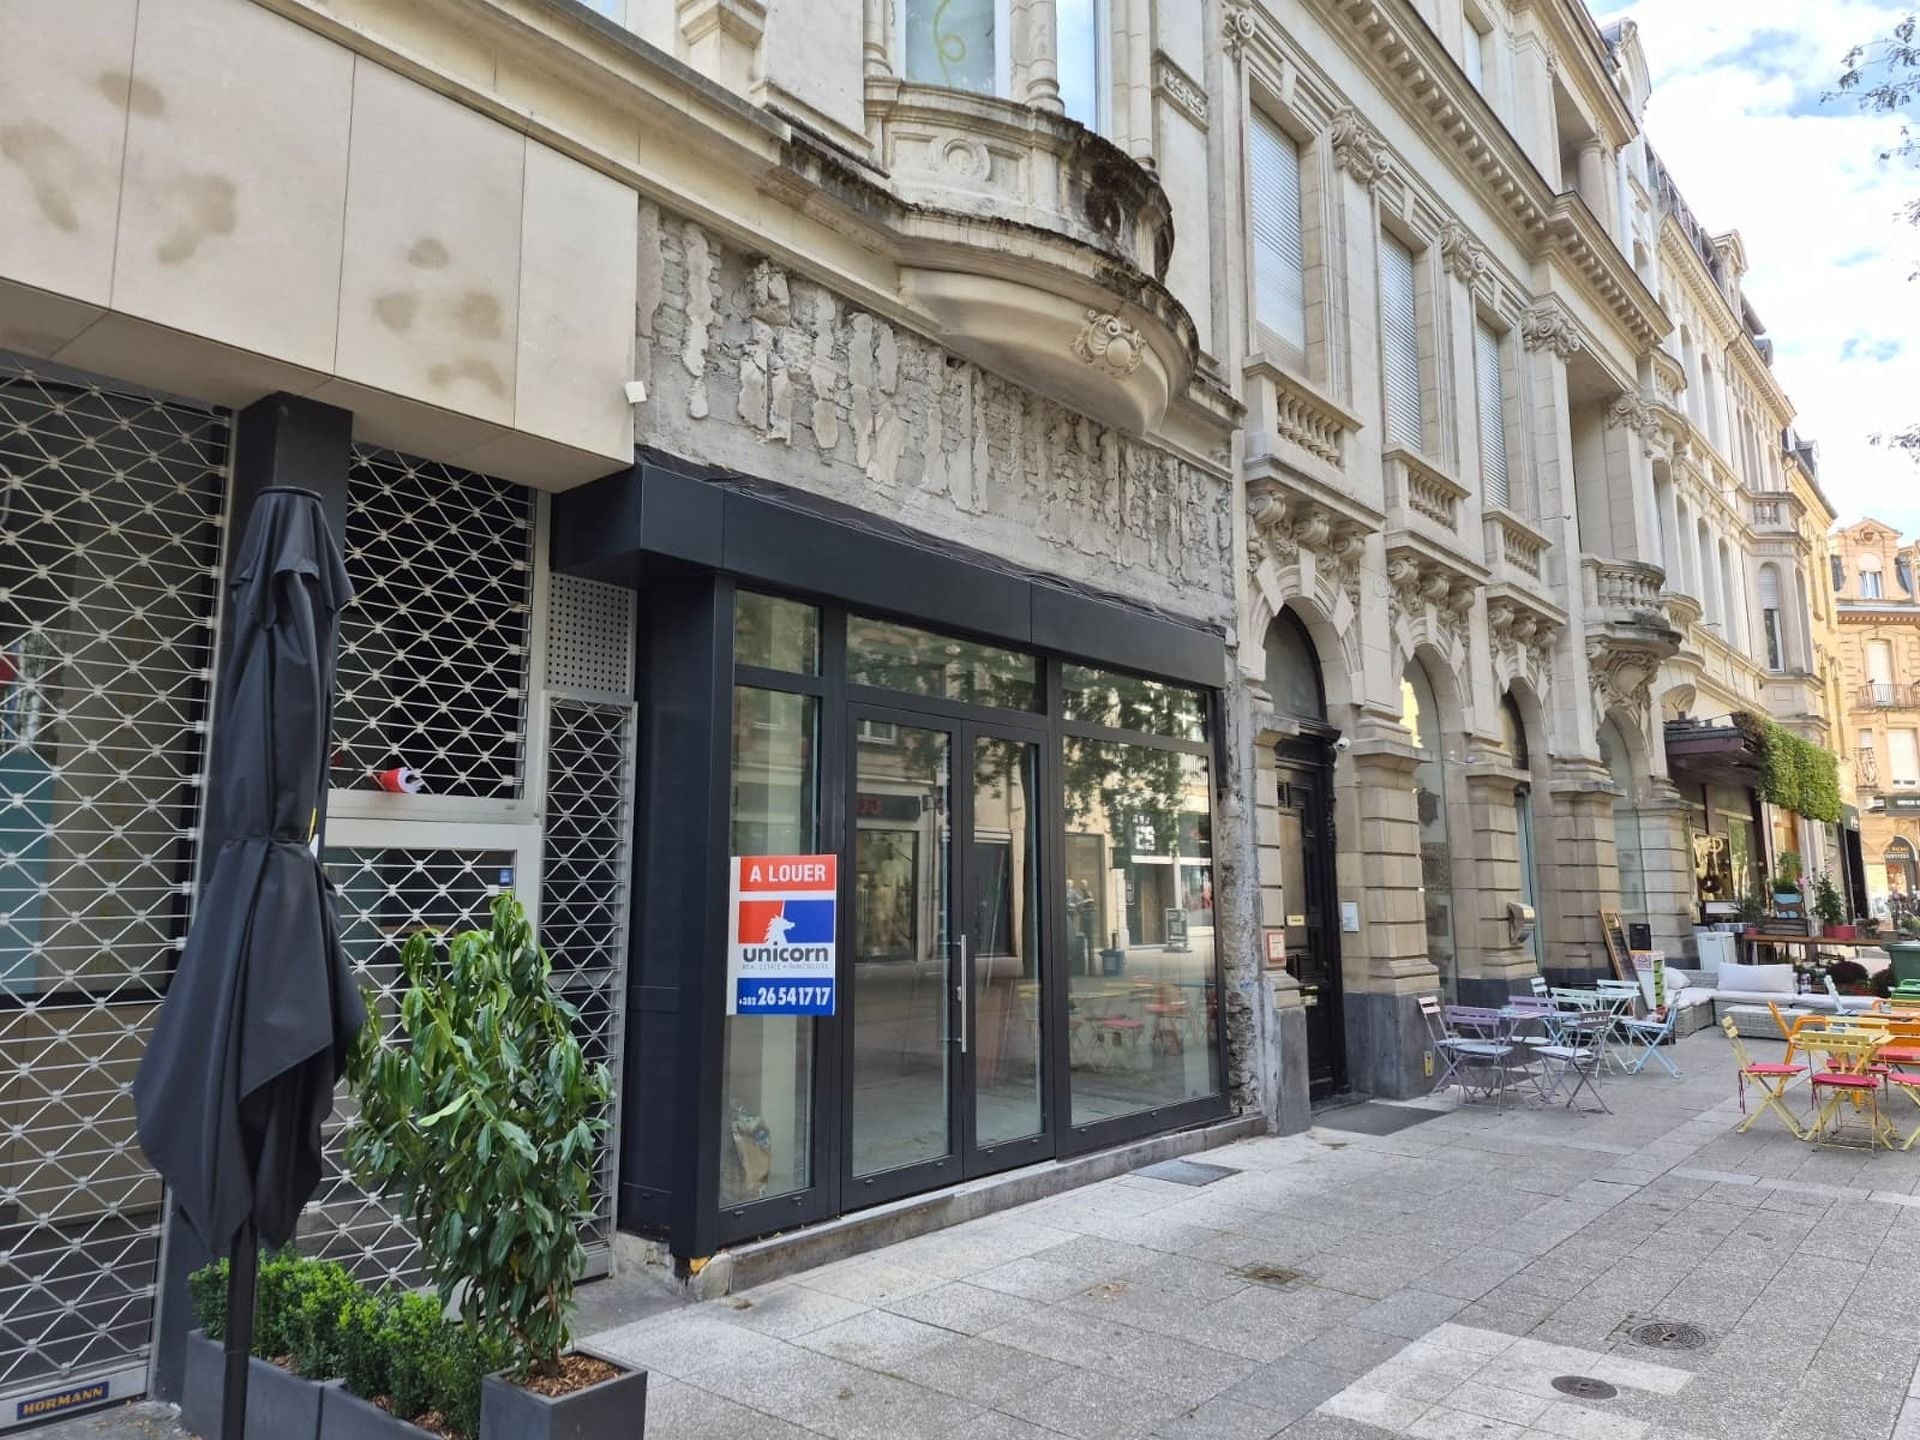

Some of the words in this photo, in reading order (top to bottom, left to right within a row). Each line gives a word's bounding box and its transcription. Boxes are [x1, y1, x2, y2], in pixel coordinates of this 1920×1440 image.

[750, 864, 762, 882] A
[768, 864, 826, 882] LOUER
[743, 941, 829, 962] unicorn
